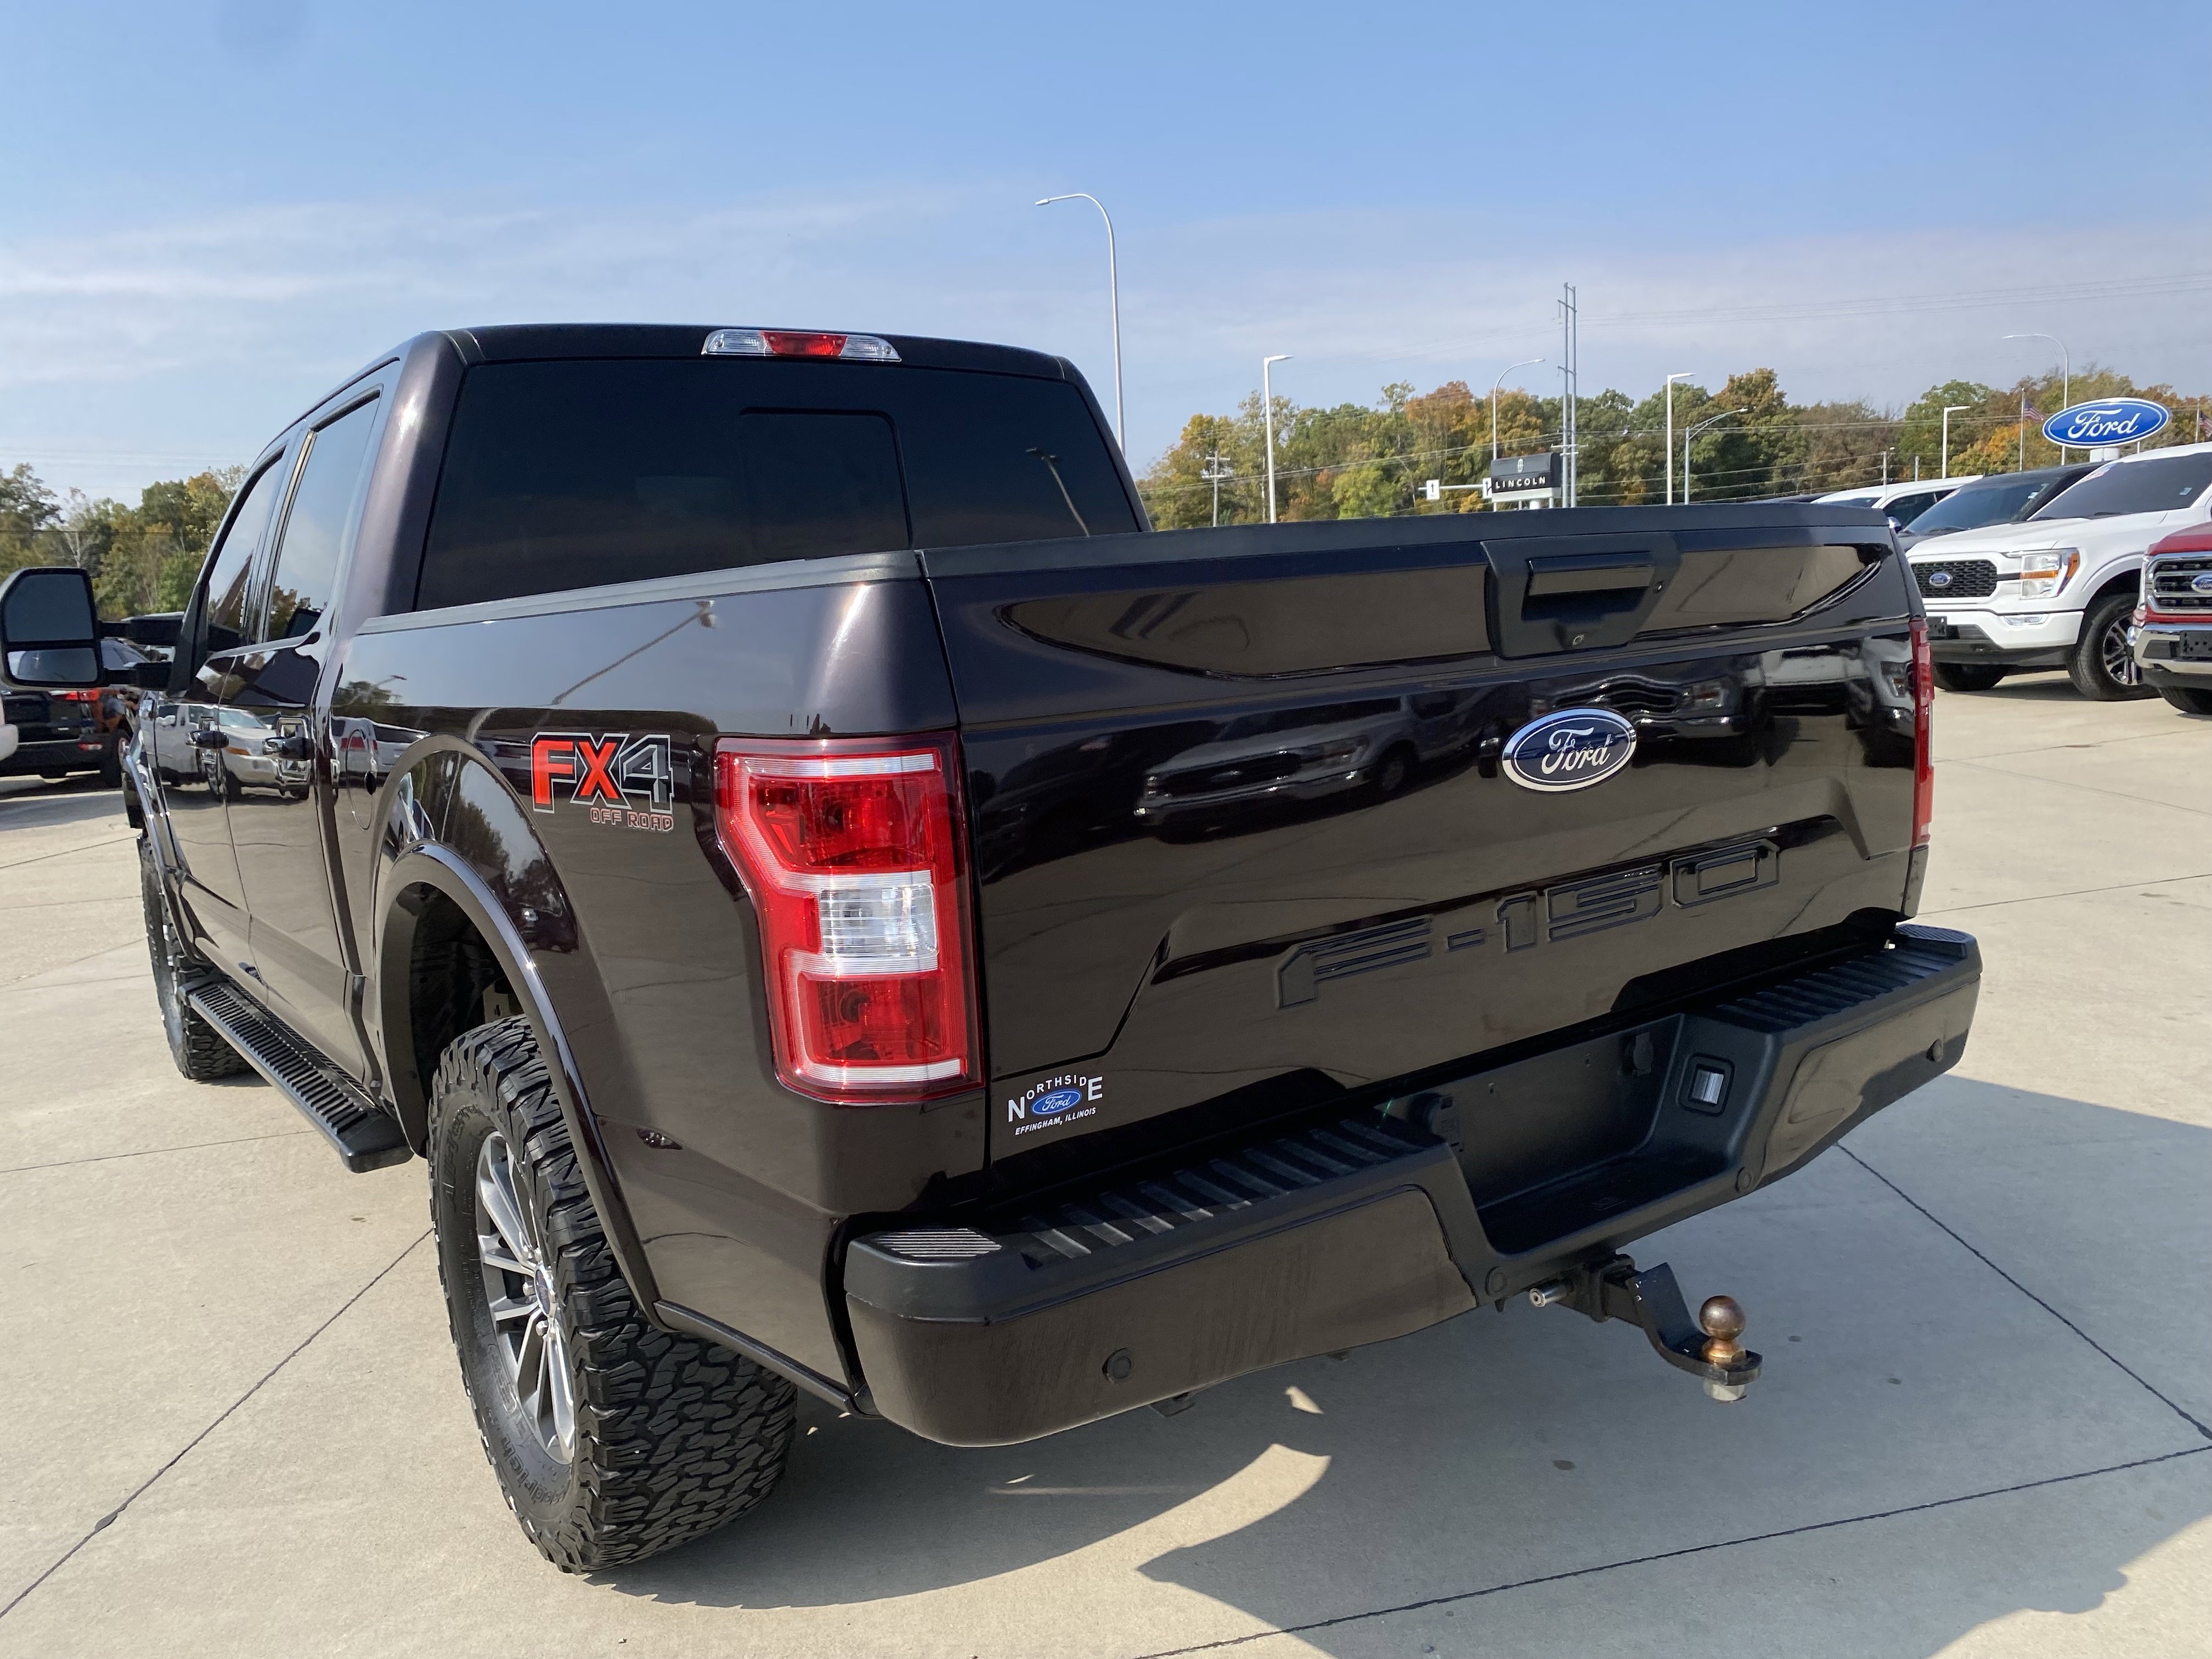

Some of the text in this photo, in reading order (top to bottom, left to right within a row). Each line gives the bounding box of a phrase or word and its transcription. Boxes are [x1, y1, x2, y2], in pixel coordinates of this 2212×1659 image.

[2068, 408, 2141, 438] Ford
[1495, 476, 1546, 489] LINCOLN
[1541, 727, 1613, 775] Ford
[531, 732, 674, 814] FX4
[590, 808, 674, 832] OFF ROAD
[1277, 838, 1780, 1009] F-150
[1008, 1074, 1103, 1122] NORTHSIDE
[1042, 1094, 1071, 1111] Ford
[1015, 1107, 1096, 1136] EFFINGHAM, ILLINOIS
